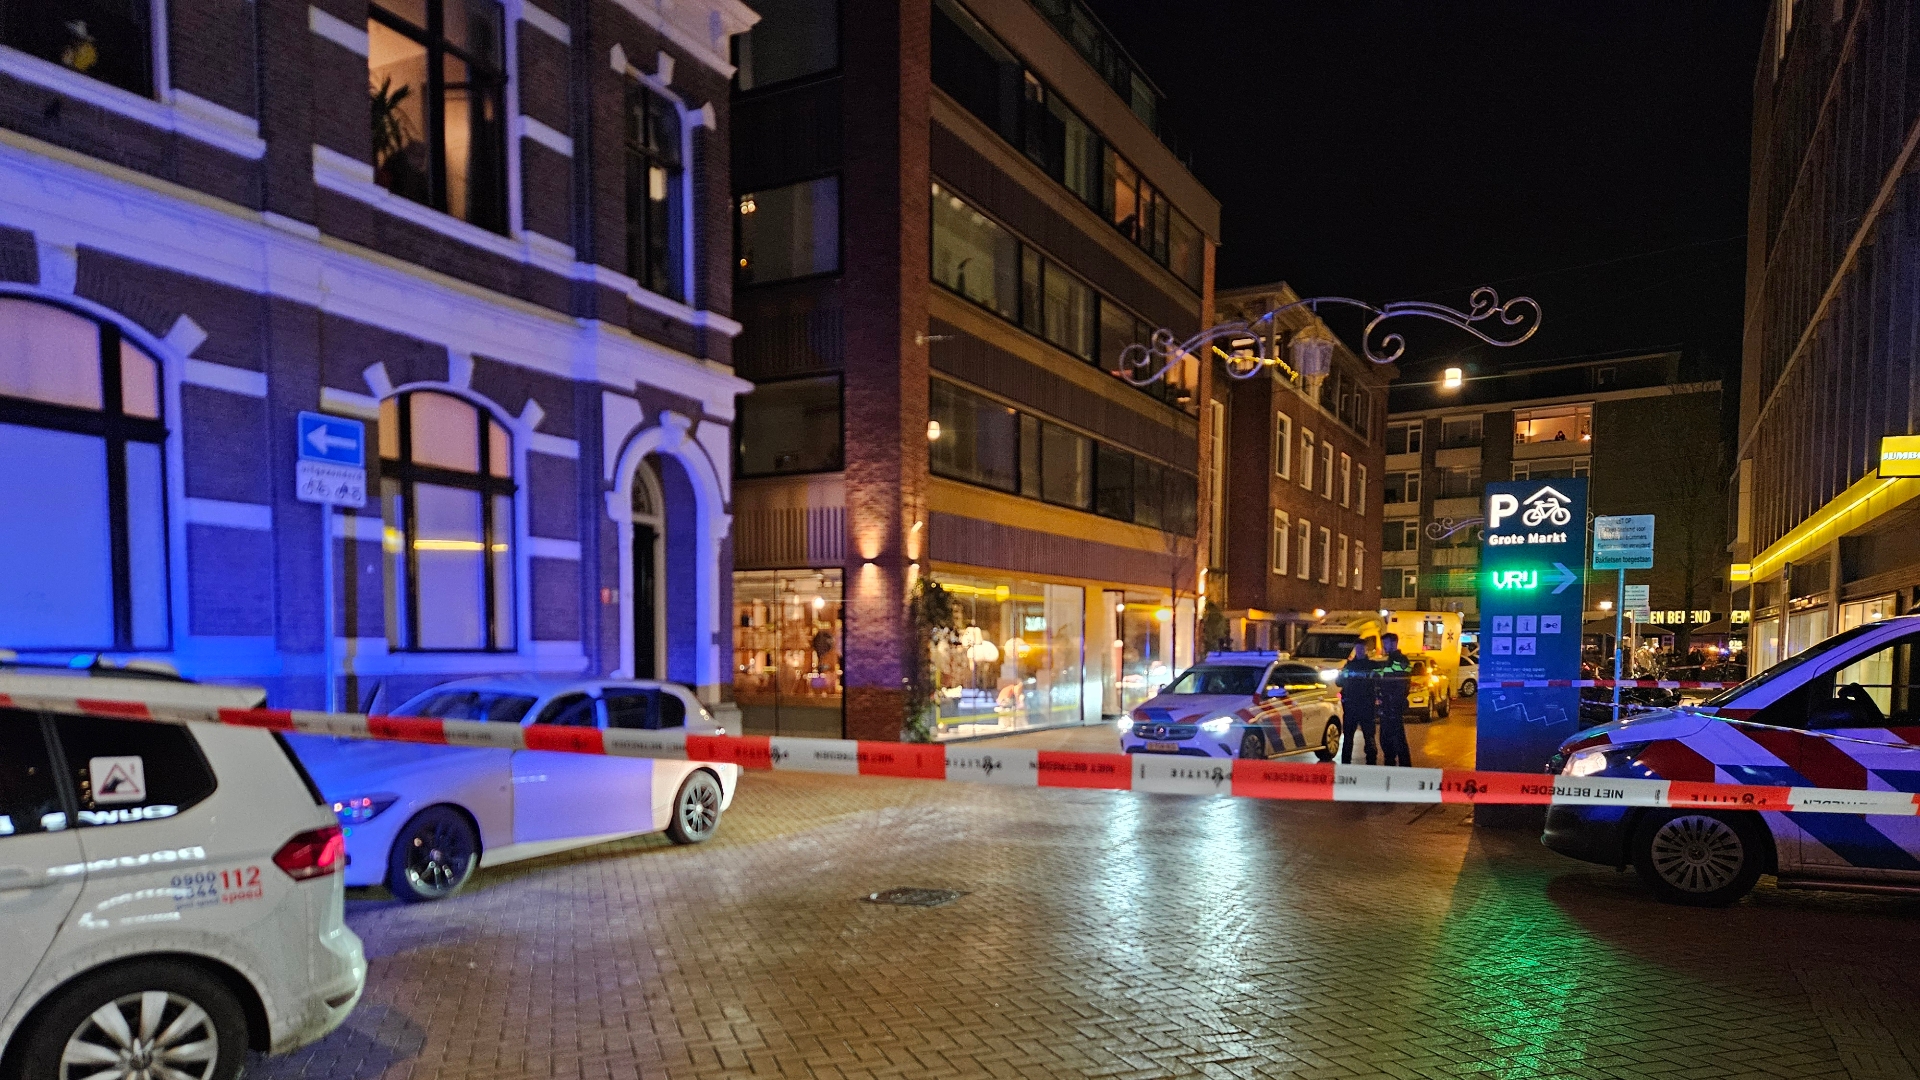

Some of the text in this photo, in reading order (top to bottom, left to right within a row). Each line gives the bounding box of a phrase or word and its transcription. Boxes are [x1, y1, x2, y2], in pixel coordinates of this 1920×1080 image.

[1489, 494, 1519, 528] P
[1488, 531, 1567, 546] Grote Markt
[1521, 784, 1624, 799] NIET BETREDEN
[171, 865, 262, 890] 0900 112
